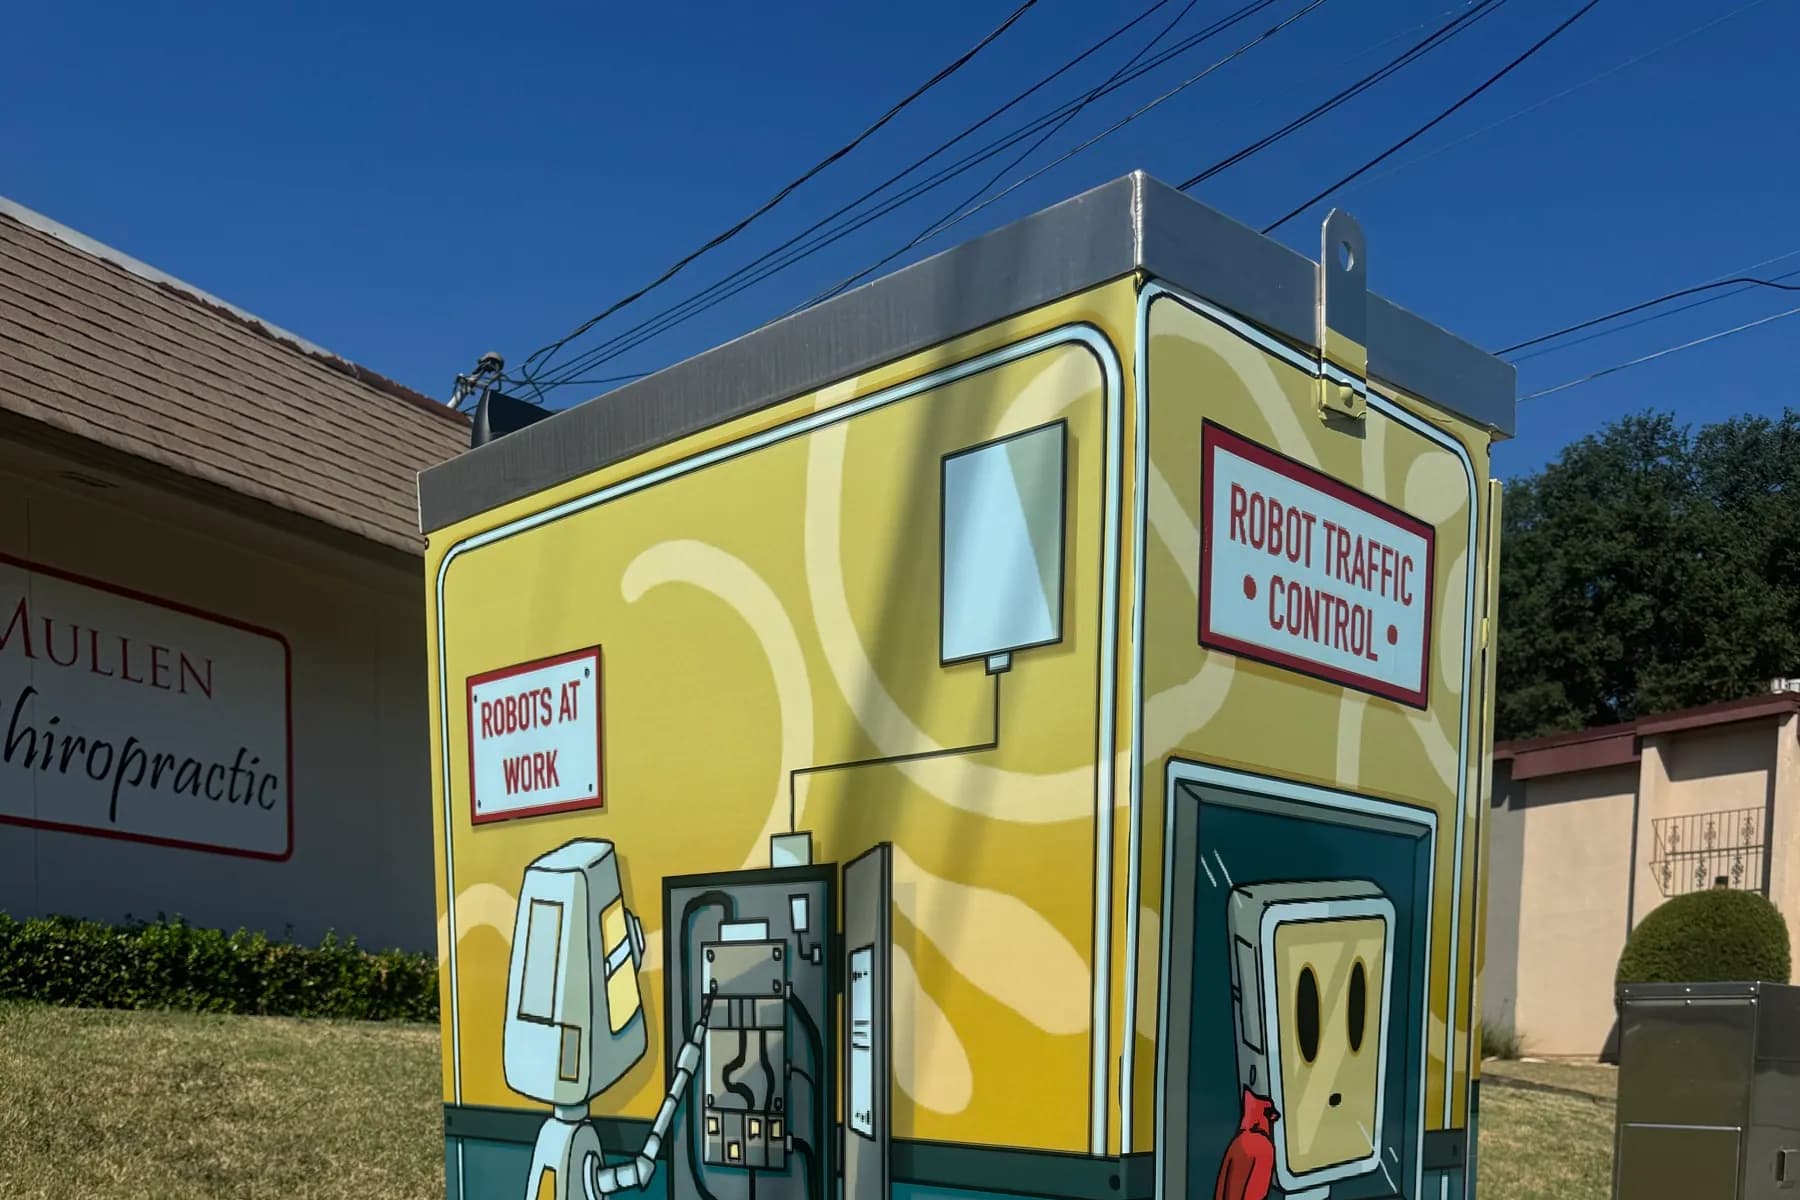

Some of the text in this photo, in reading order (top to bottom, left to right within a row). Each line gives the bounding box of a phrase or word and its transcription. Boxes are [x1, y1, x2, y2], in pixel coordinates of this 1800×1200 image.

[1230, 482, 1413, 606] ROBOT TRAFFIC
[1269, 575, 1378, 661] CONTROL
[481, 679, 580, 739] ROBOTS AT
[0, 685, 277, 822] hiropractic
[503, 749, 560, 795] WORK
